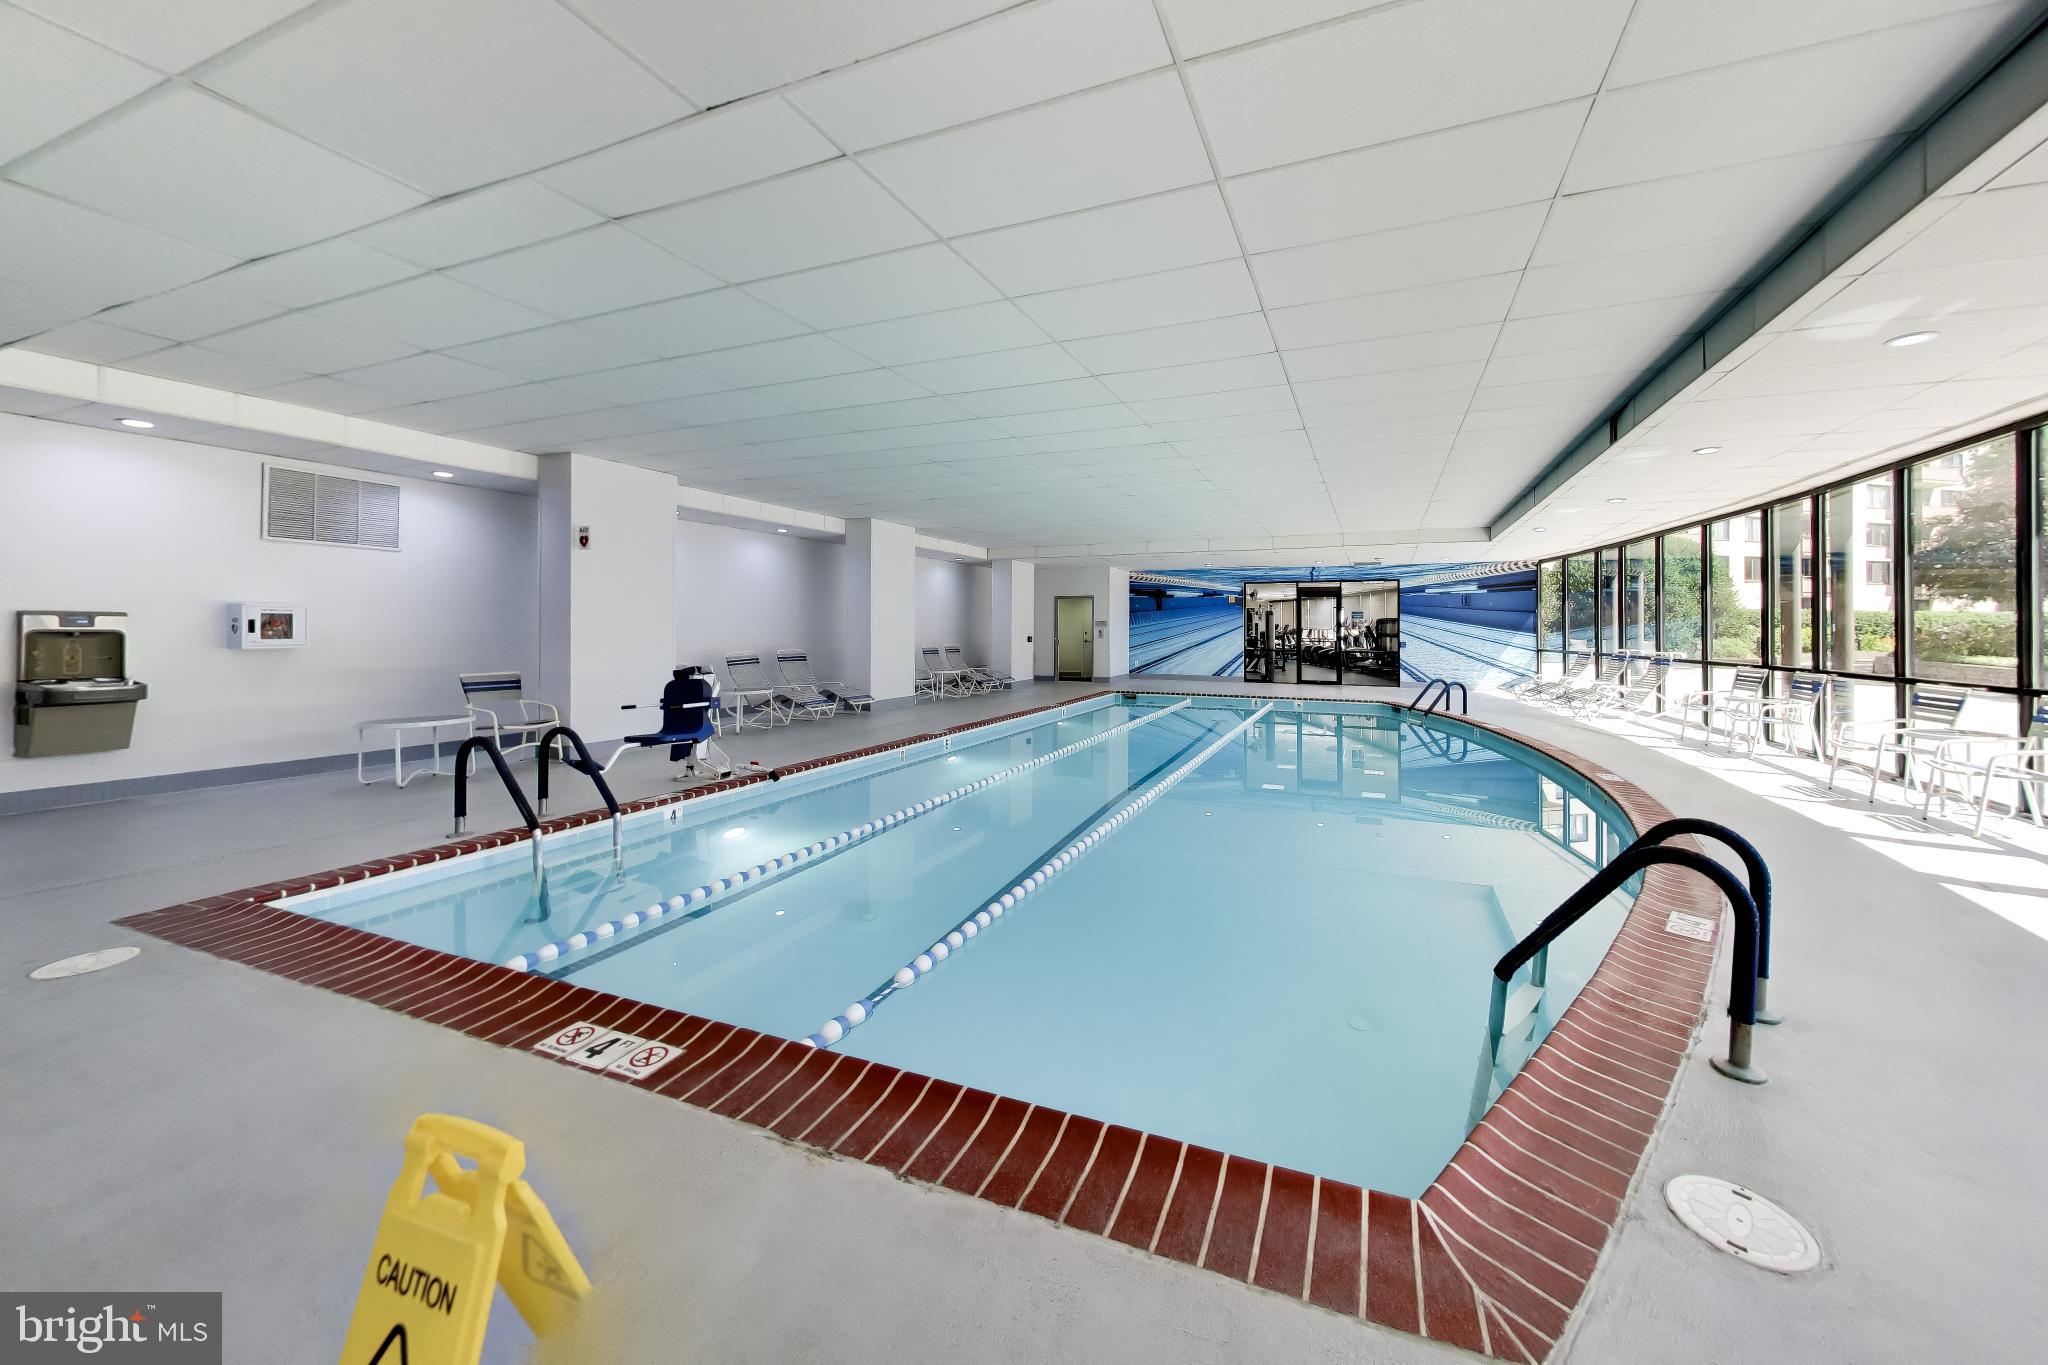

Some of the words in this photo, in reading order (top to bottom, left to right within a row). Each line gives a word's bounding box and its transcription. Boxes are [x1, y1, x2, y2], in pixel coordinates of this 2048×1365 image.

[584, 1037, 622, 1059] 4
[619, 1040, 635, 1048] FT
[376, 1253, 458, 1316] CAUTION
